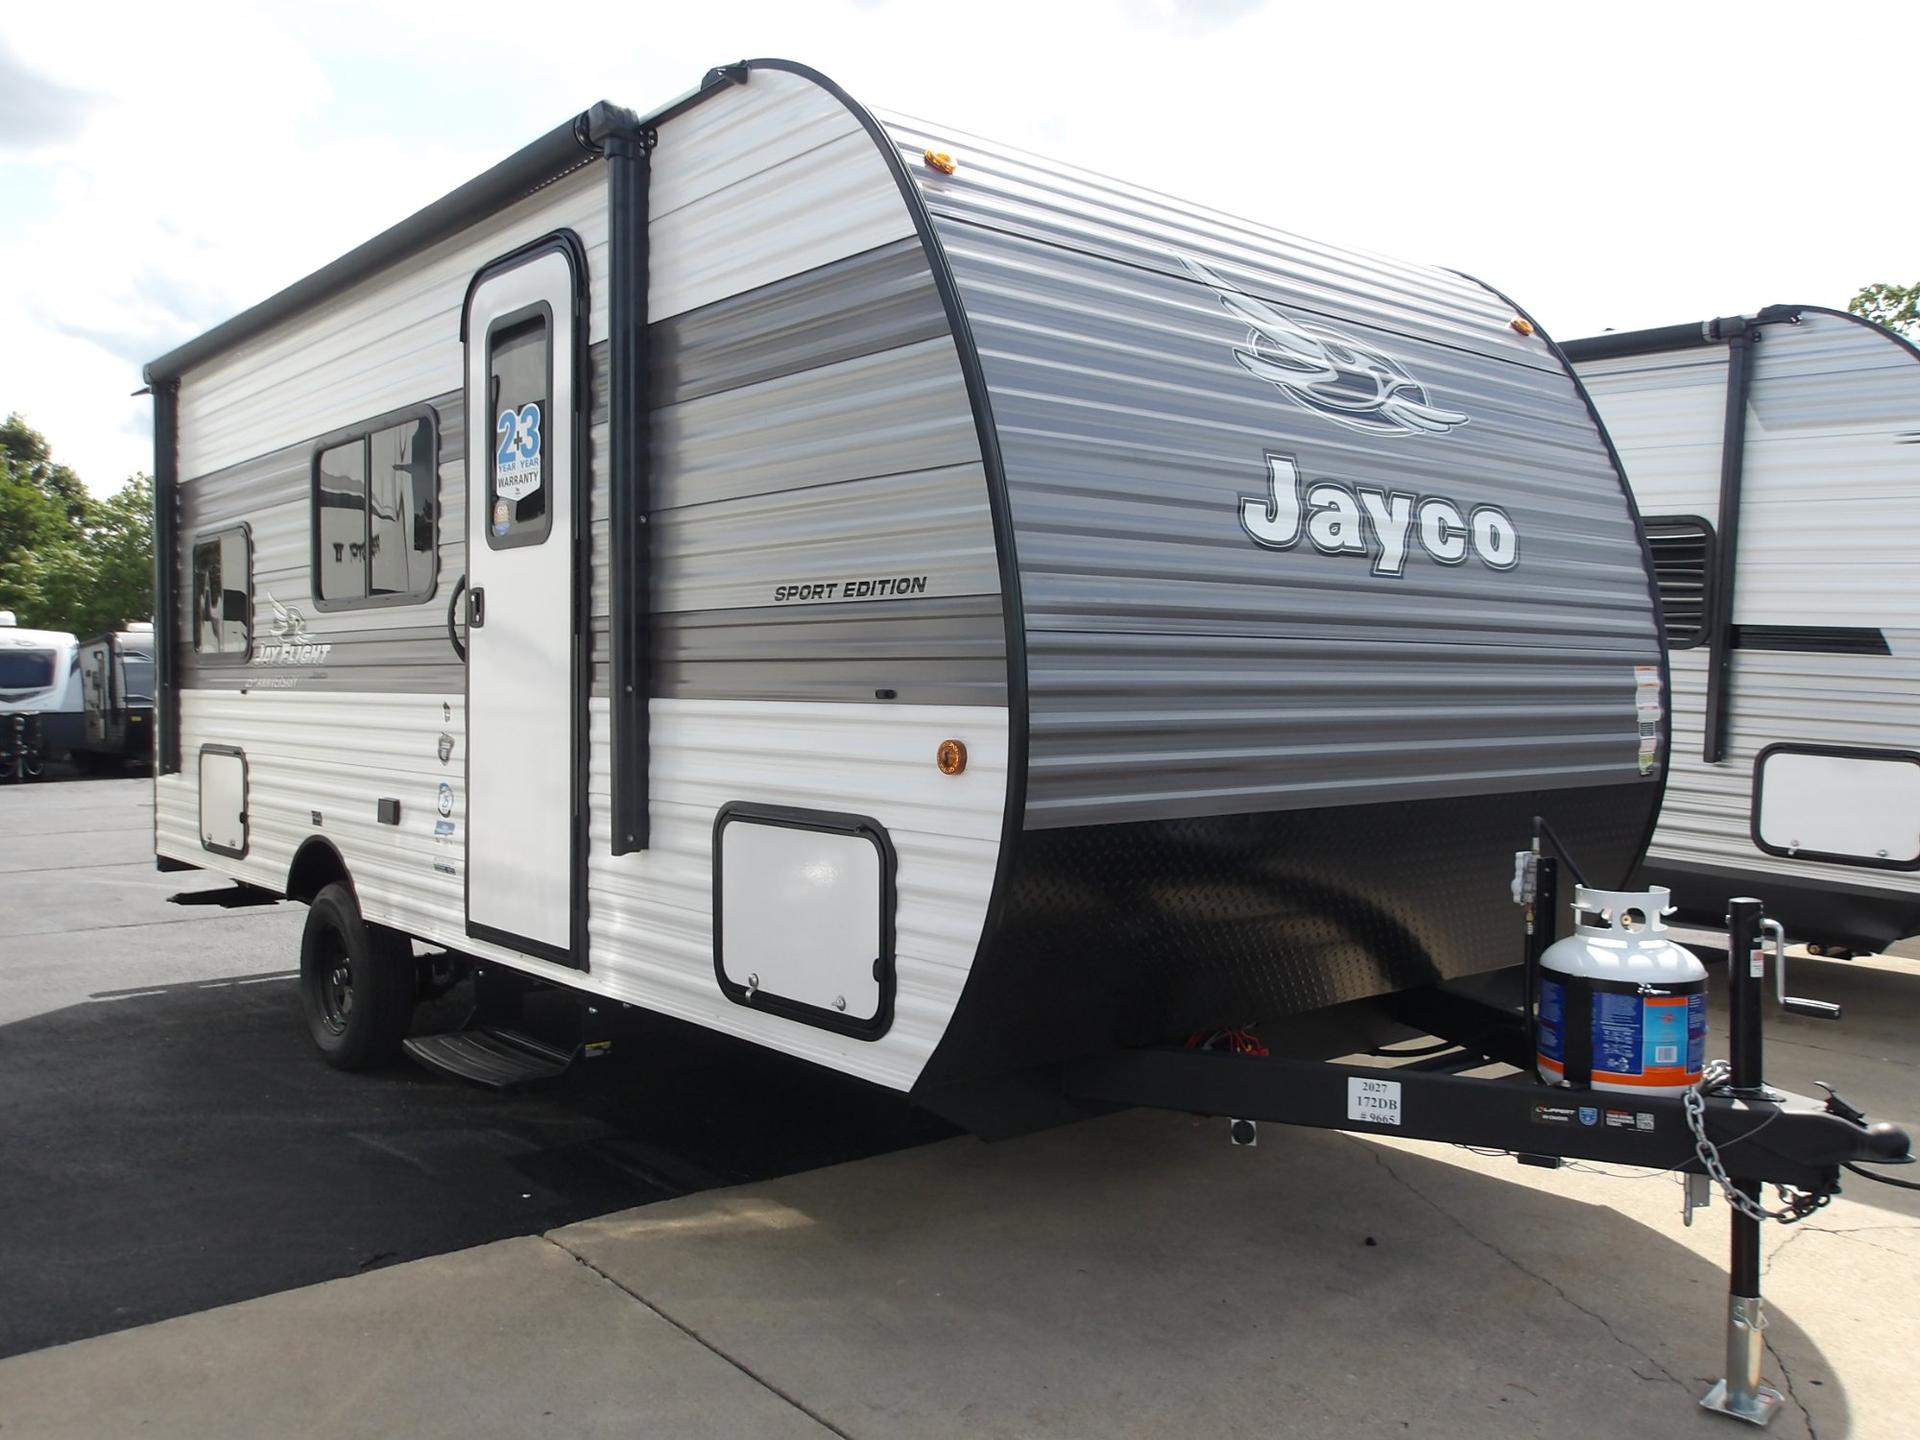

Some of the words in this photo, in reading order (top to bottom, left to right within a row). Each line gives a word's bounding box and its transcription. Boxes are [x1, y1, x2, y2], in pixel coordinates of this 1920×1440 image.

[499, 463, 516, 473] YEAR
[520, 458, 539, 469] YEAR
[498, 471, 539, 488] WARRANTY
[1238, 450, 1520, 577] Jayco
[774, 583, 838, 602] SPORT
[842, 576, 927, 598] EDITION
[280, 643, 331, 664] FLIGHT
[1362, 1081, 1387, 1093] 2027
[1357, 1095, 1398, 1110] 172DB
